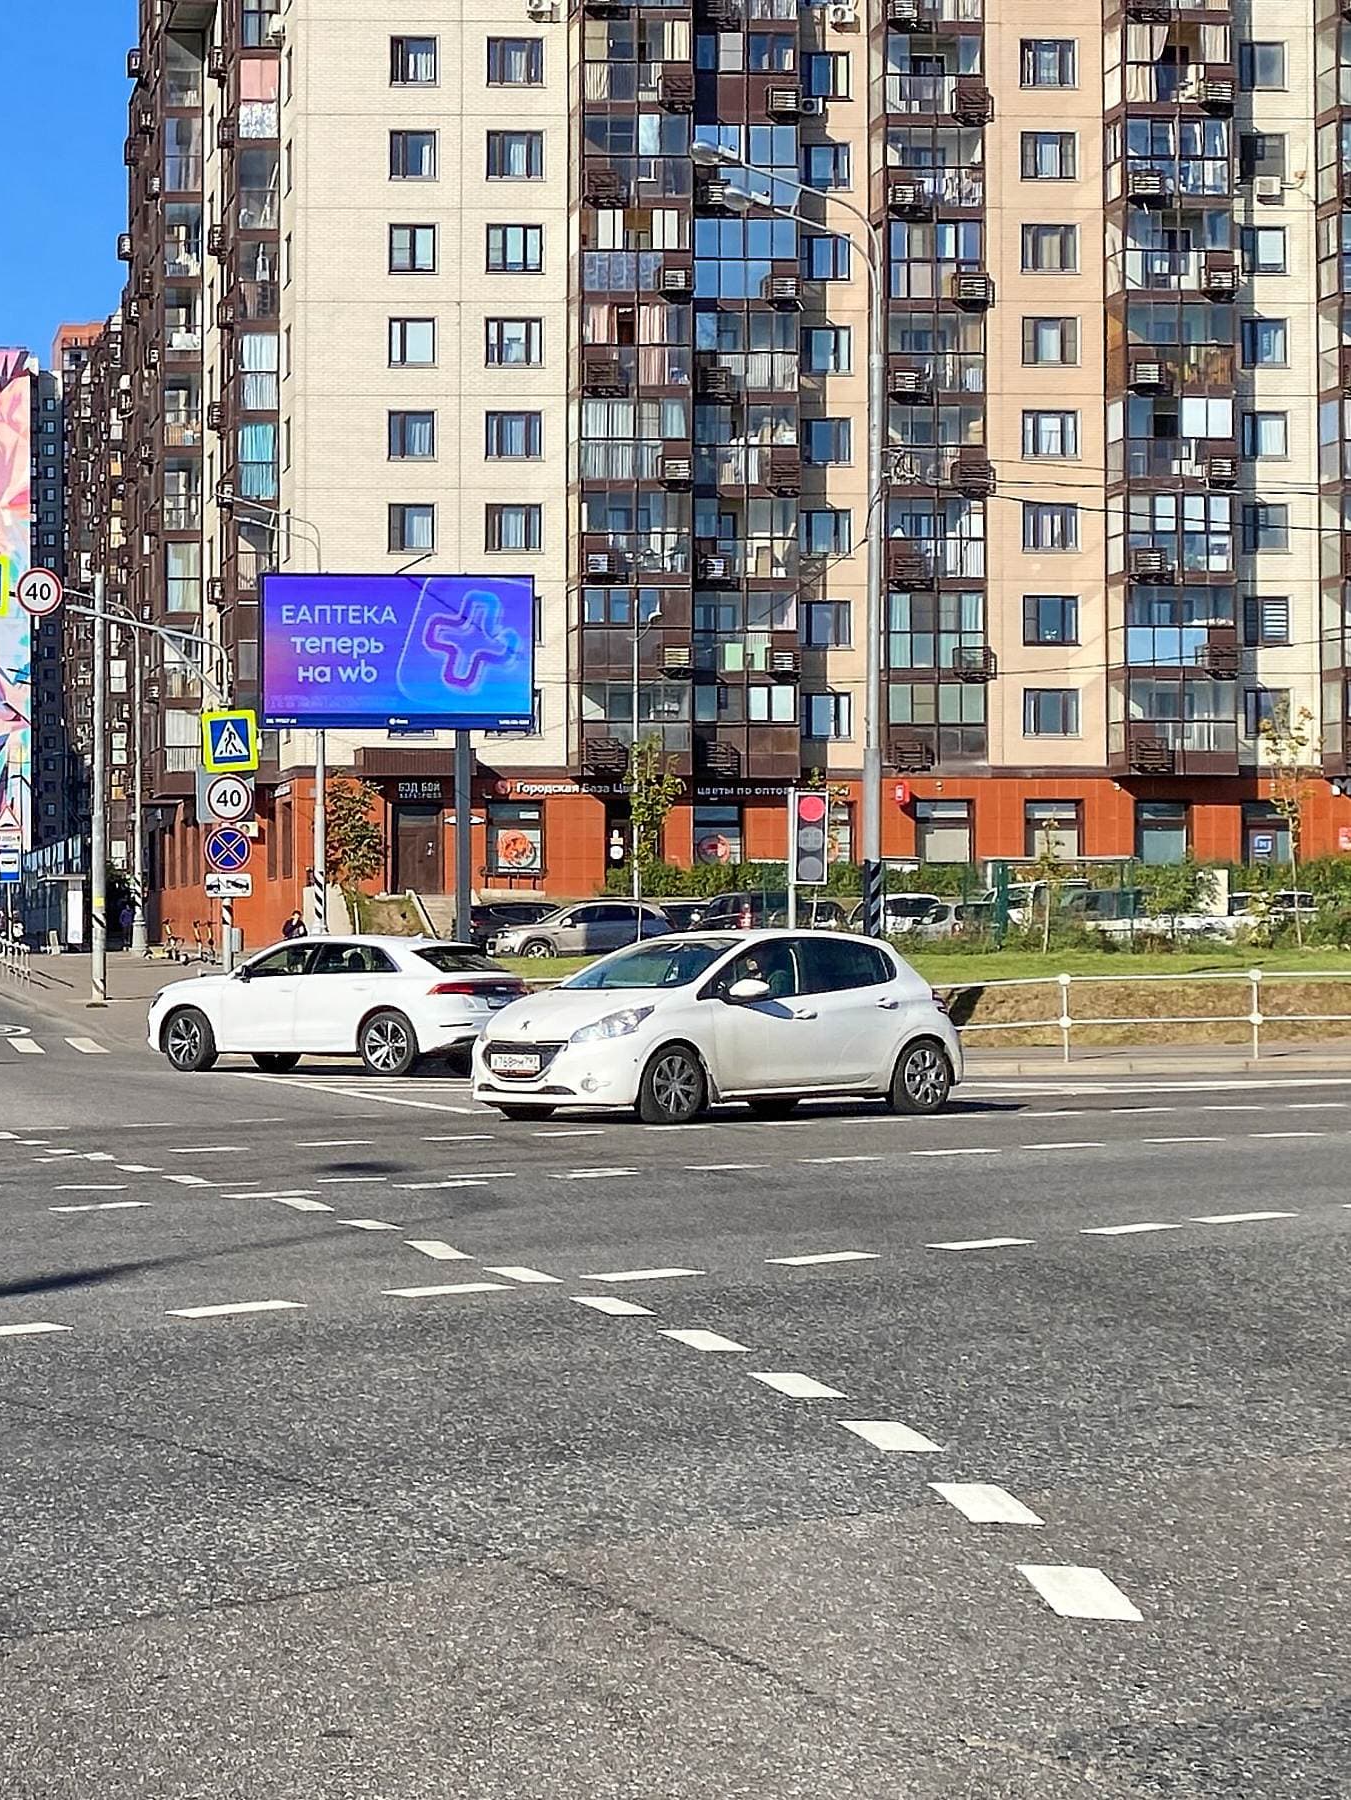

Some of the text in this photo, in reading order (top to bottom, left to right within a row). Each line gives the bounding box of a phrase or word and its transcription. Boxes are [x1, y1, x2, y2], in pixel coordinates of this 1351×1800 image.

[25, 582, 51, 601] 40
[281, 604, 398, 625] ЕАПТЕКА
[290, 636, 385, 660] теперь
[297, 659, 378, 683] на wb
[216, 789, 242, 807] 40
[516, 781, 580, 795] Городская
